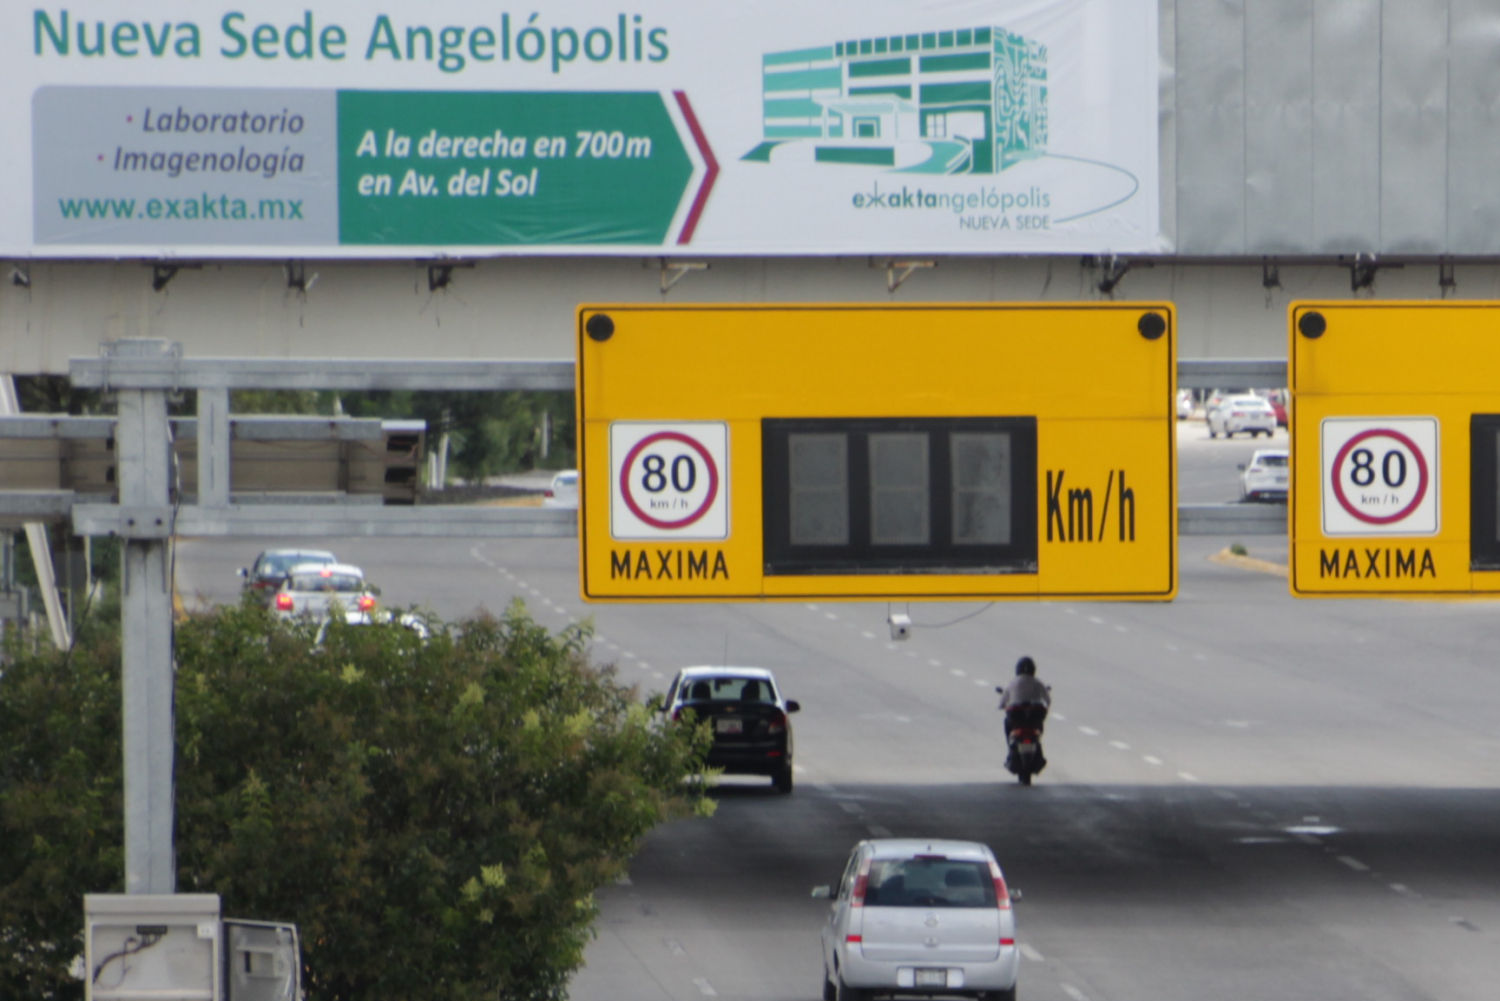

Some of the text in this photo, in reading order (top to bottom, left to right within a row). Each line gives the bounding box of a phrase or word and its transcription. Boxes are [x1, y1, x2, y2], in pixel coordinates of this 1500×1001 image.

[33, 9, 670, 73] Nueva Sede Angelópolis
[142, 107, 305, 134] Laboratorio
[356, 130, 378, 158] A
[385, 129, 411, 158] la
[417, 129, 527, 158] derecha
[533, 136, 567, 158] en
[114, 147, 305, 177] Imagenología
[357, 167, 539, 196] en Av. del Sol
[58, 193, 304, 220] www.exakta.mx
[959, 215, 1050, 231] NUEVA SEDE
[640, 454, 697, 493] 80
[1349, 448, 1408, 488] 80
[1046, 469, 1136, 543] Km/h
[610, 550, 730, 580] MAXIMA
[1319, 548, 1437, 579] MAXIMA
